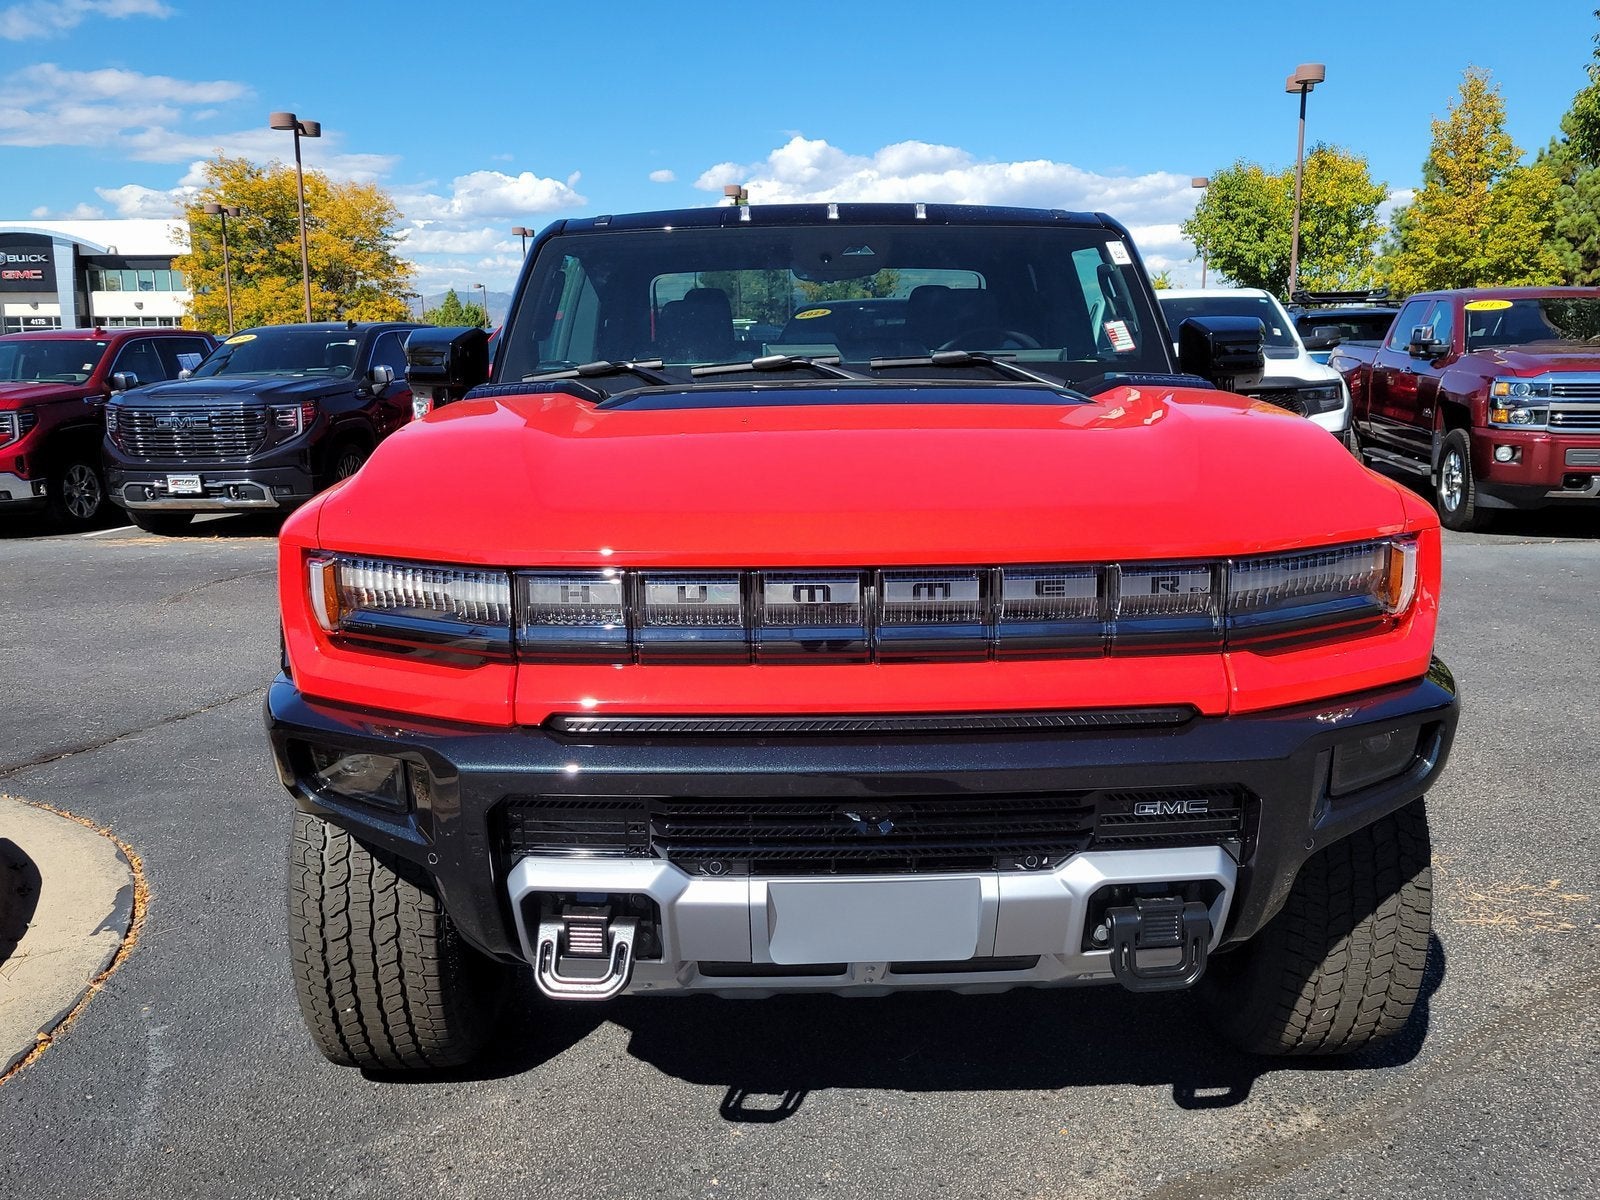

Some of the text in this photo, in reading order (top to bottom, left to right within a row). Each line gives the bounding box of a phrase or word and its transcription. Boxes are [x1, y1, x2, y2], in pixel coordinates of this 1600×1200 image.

[7, 254, 49, 262] BUICK
[2, 269, 43, 279] GMC
[155, 416, 210, 428] GMC
[1134, 799, 1209, 816] GMC
